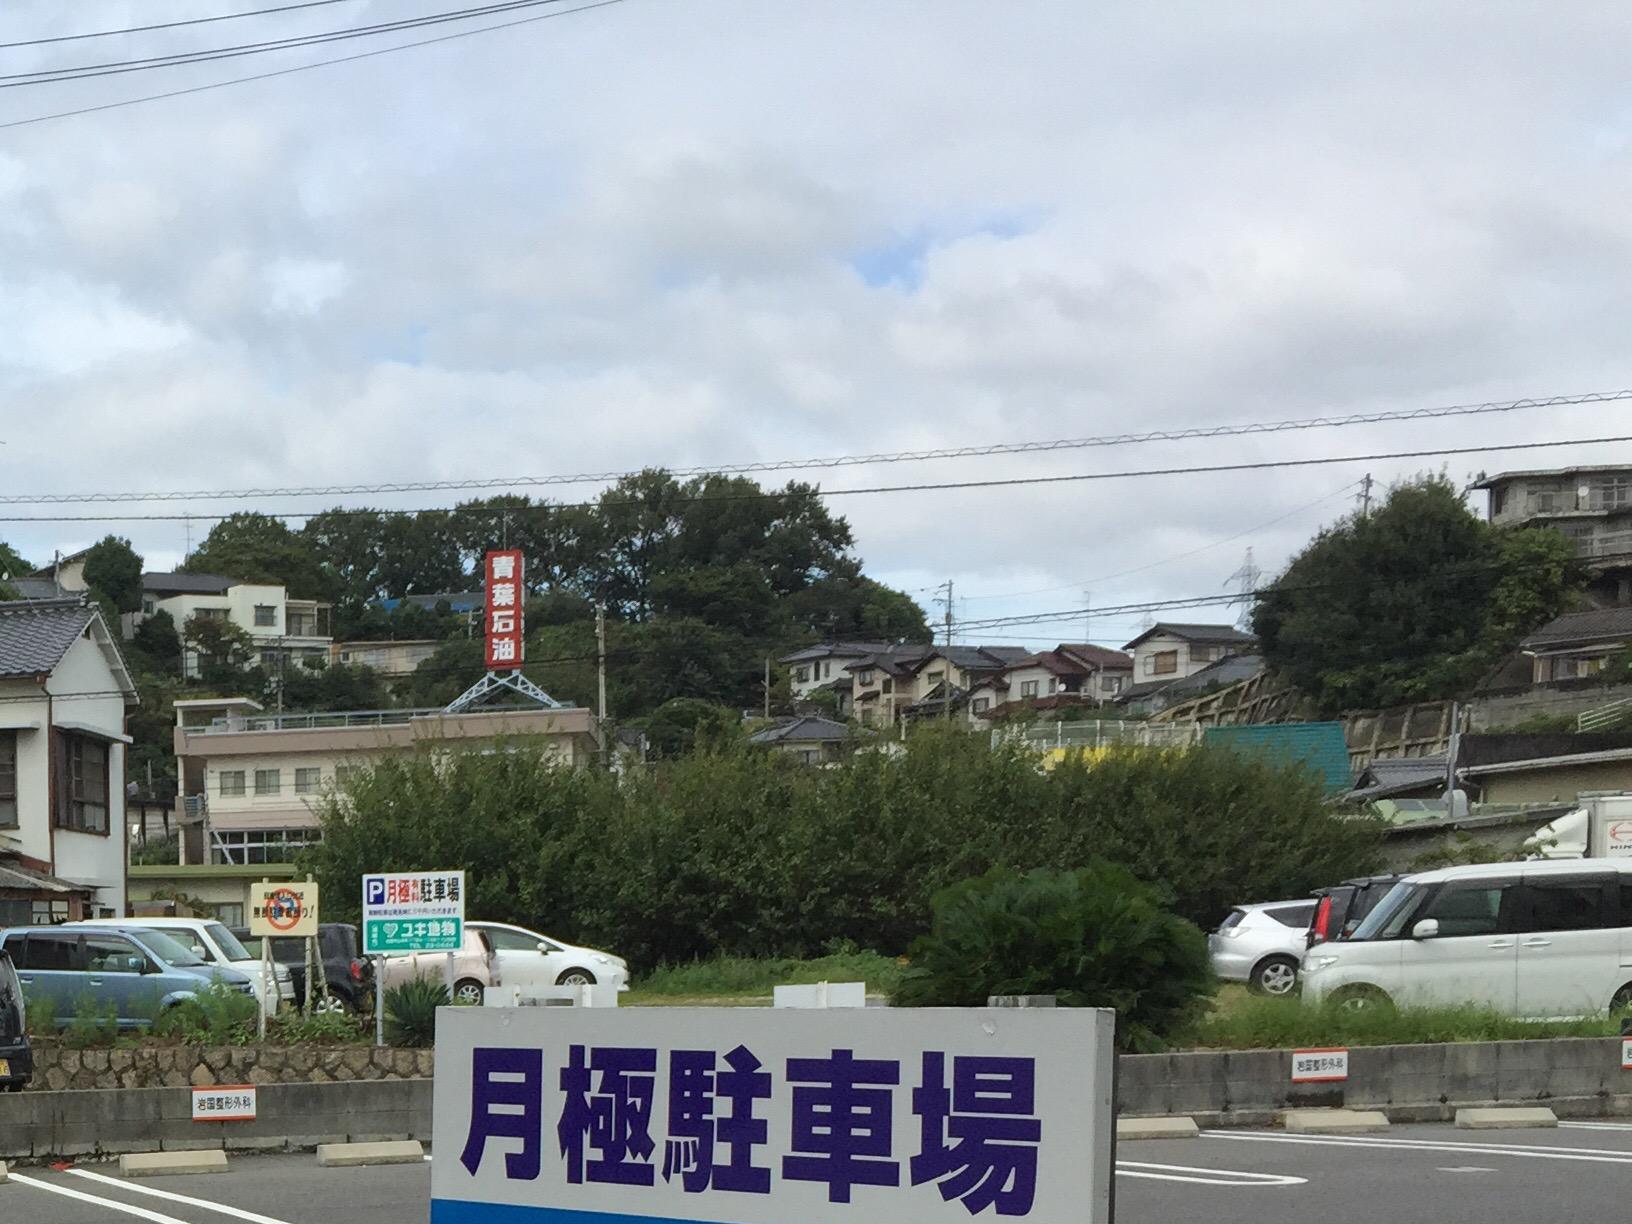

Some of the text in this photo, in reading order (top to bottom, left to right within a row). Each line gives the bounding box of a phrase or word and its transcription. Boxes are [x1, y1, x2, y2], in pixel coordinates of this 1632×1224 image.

[492, 556, 515, 660] 青葉石油
[198, 1096, 251, 1111] 岩国整形外科
[459, 1044, 1041, 1217] 月極駐車場
